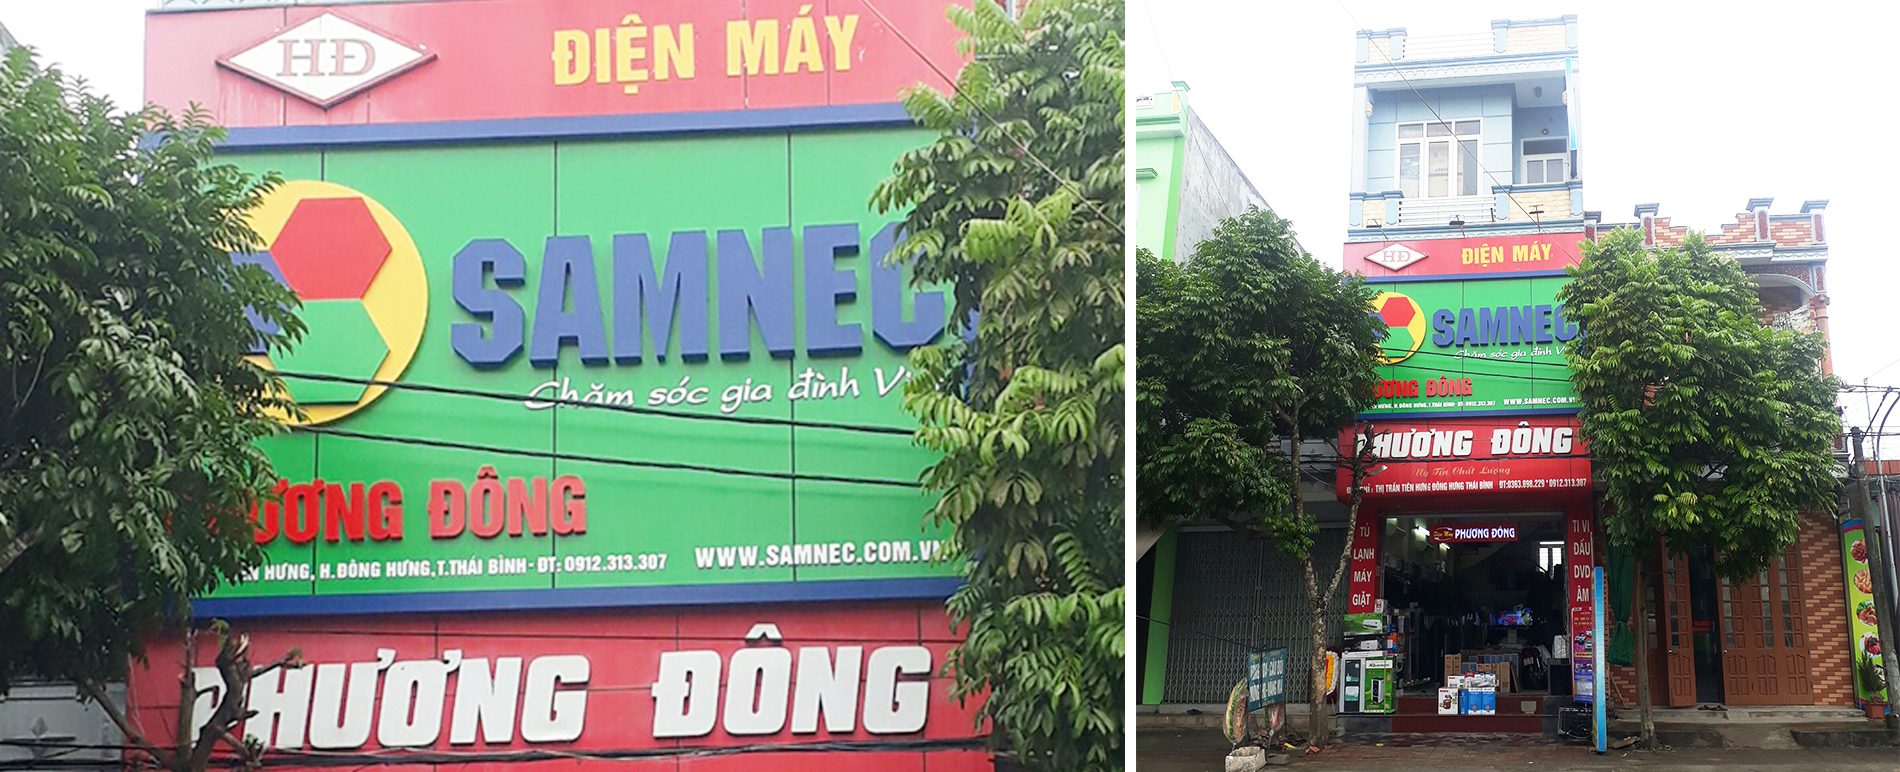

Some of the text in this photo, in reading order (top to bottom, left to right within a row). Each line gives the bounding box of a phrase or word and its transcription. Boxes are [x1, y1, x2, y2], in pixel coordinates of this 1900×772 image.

[276, 39, 376, 77] HĐ
[553, 6, 859, 94] ĐIỆN MÁY
[1381, 250, 1411, 263] HĐ
[1462, 240, 1552, 268] ĐIỆN MÁY
[450, 221, 946, 370] SAMNEC
[1432, 304, 1577, 347] SAMNEC
[1453, 348, 1487, 359] Chăm
[1489, 348, 1508, 358] sóc
[1511, 349, 1527, 361] gia
[1530, 346, 1552, 356] đình
[524, 376, 635, 410] Chăm
[648, 376, 710, 406] sóc
[721, 378, 773, 413] gia
[788, 369, 860, 401] đình
[1366, 374, 1472, 398] ƯƠNG ĐÔNG
[1491, 420, 1573, 456] ĐÔNG
[1465, 479, 1479, 490] THÁI
[1548, 477, 1587, 488] 0912.313.307
[225, 466, 588, 544] ƯƠNG ĐÔNG
[1360, 522, 1370, 537] TỦ
[1454, 527, 1490, 540] PHƯƠNG
[1490, 525, 1516, 539] ĐÔNG
[1572, 520, 1590, 533] TI VI
[1353, 548, 1375, 562] LẠNH
[264, 562, 316, 581] HƯNG,
[564, 553, 667, 573] 0912.313.307
[1353, 568, 1372, 583] MÁY
[1573, 564, 1591, 579] DVD
[1352, 591, 1371, 607] GIẶT
[1576, 584, 1590, 602] ÂM
[650, 623, 933, 738] ĐÔNG
